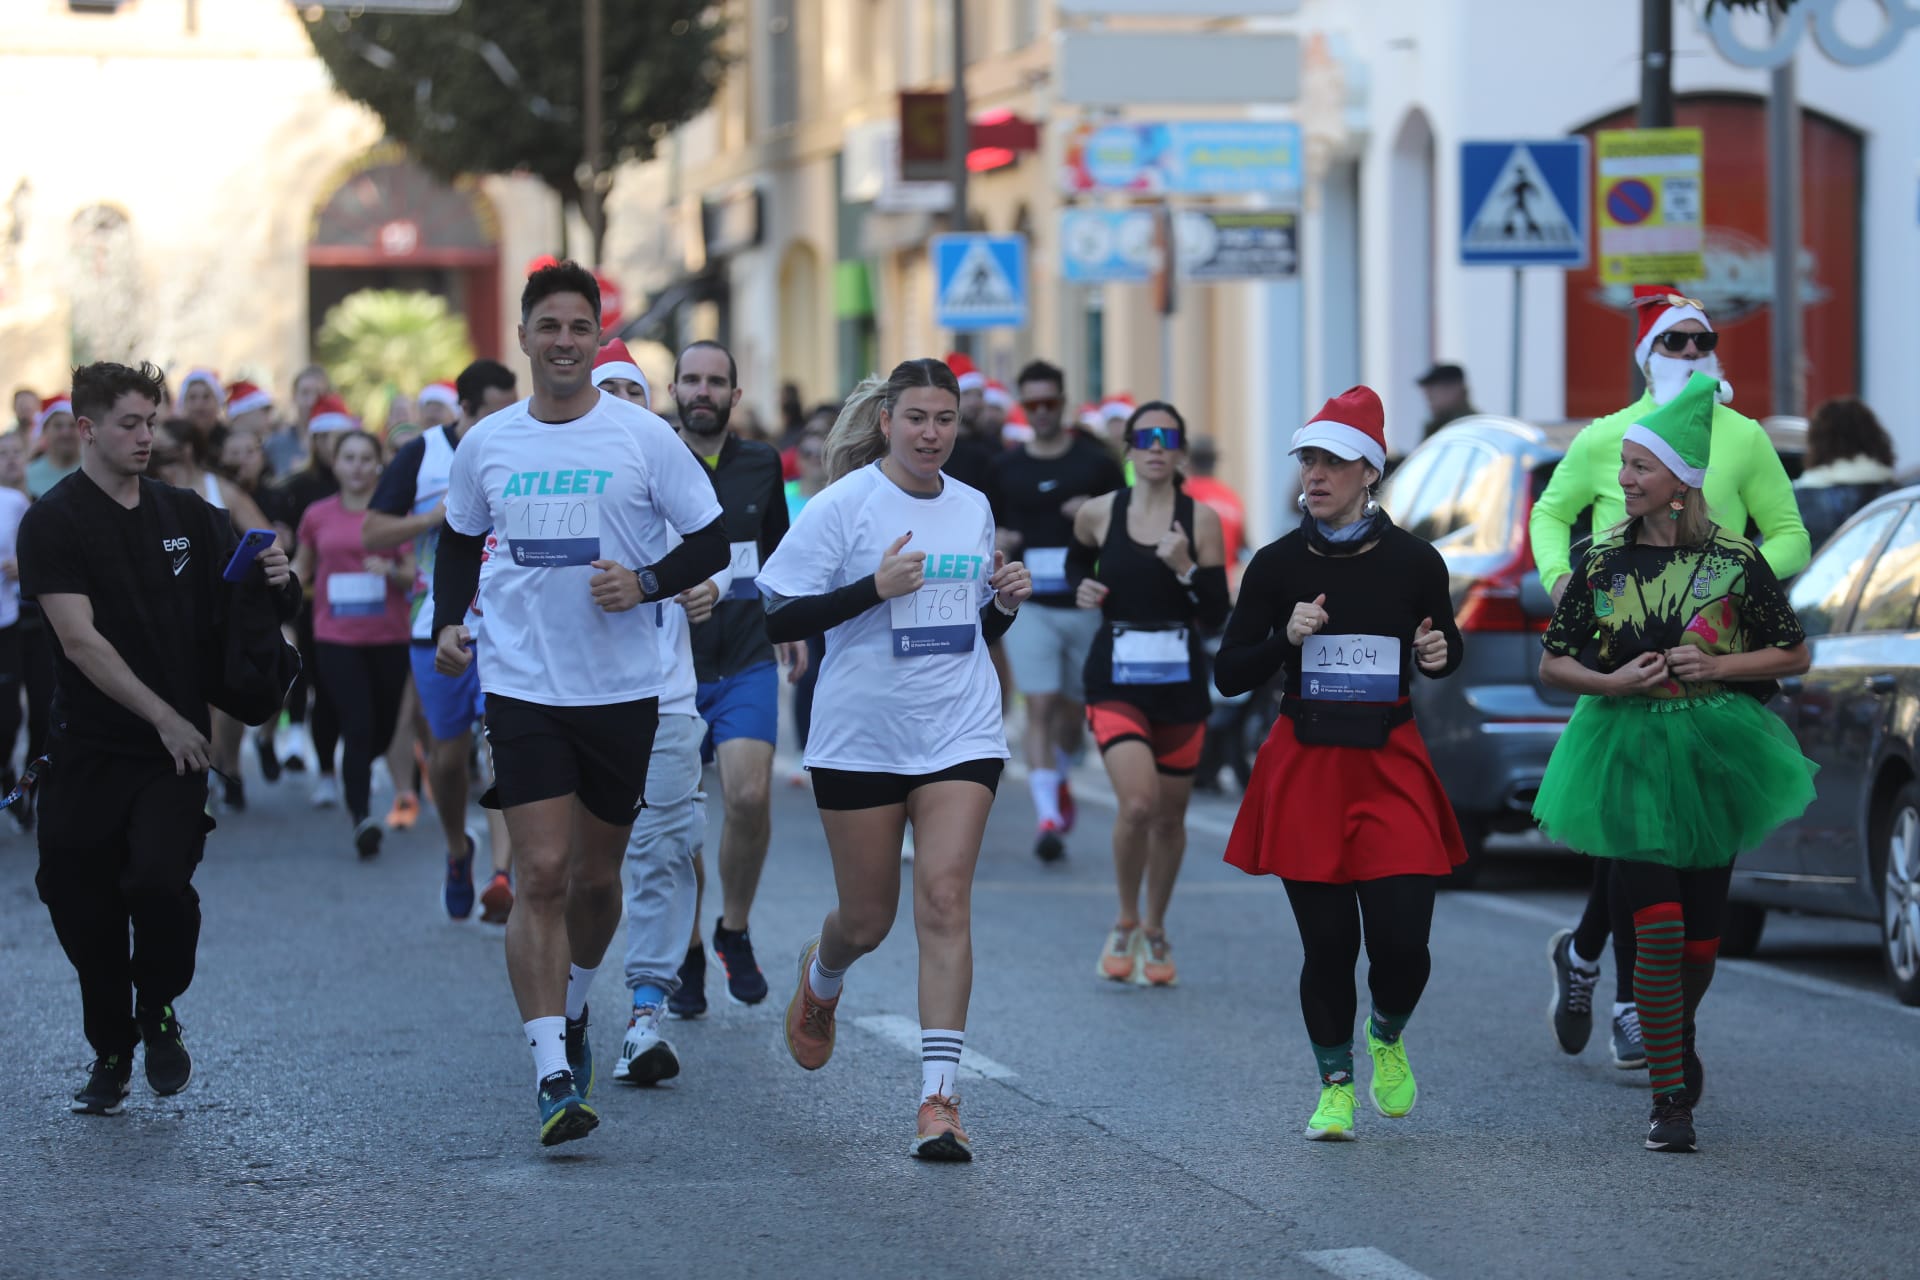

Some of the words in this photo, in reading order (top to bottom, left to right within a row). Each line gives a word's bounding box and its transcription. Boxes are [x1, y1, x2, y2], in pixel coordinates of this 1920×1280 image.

[502, 469, 614, 499] ATLEET
[520, 502, 587, 537] 1770
[924, 553, 983, 580] LEET
[907, 588, 968, 625] 1769
[1317, 645, 1377, 667] 1104
